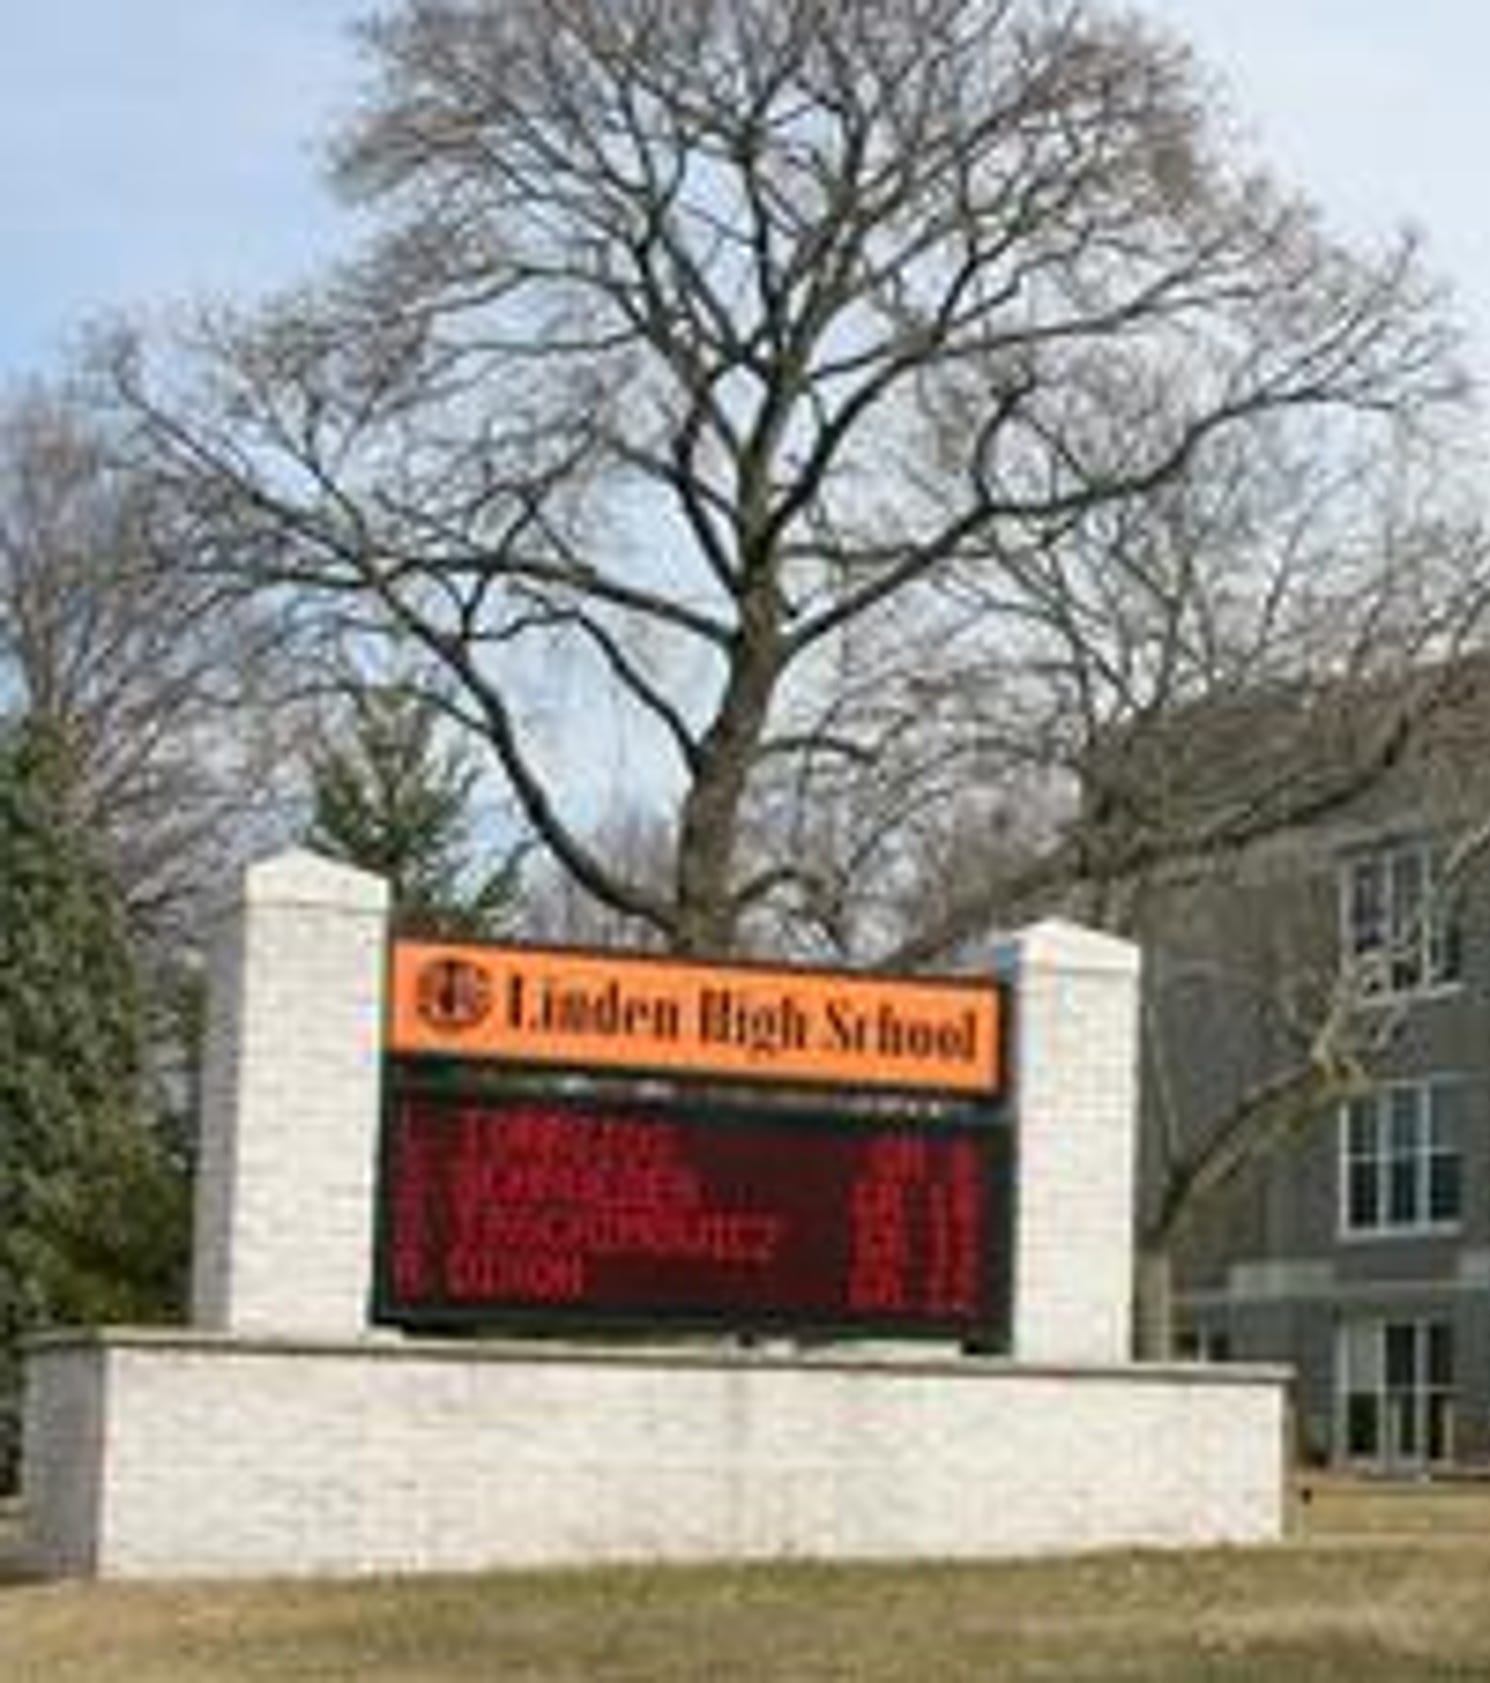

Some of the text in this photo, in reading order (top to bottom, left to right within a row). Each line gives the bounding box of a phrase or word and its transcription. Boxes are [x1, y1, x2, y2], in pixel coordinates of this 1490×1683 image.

[506, 972, 978, 1066] Linden High School
